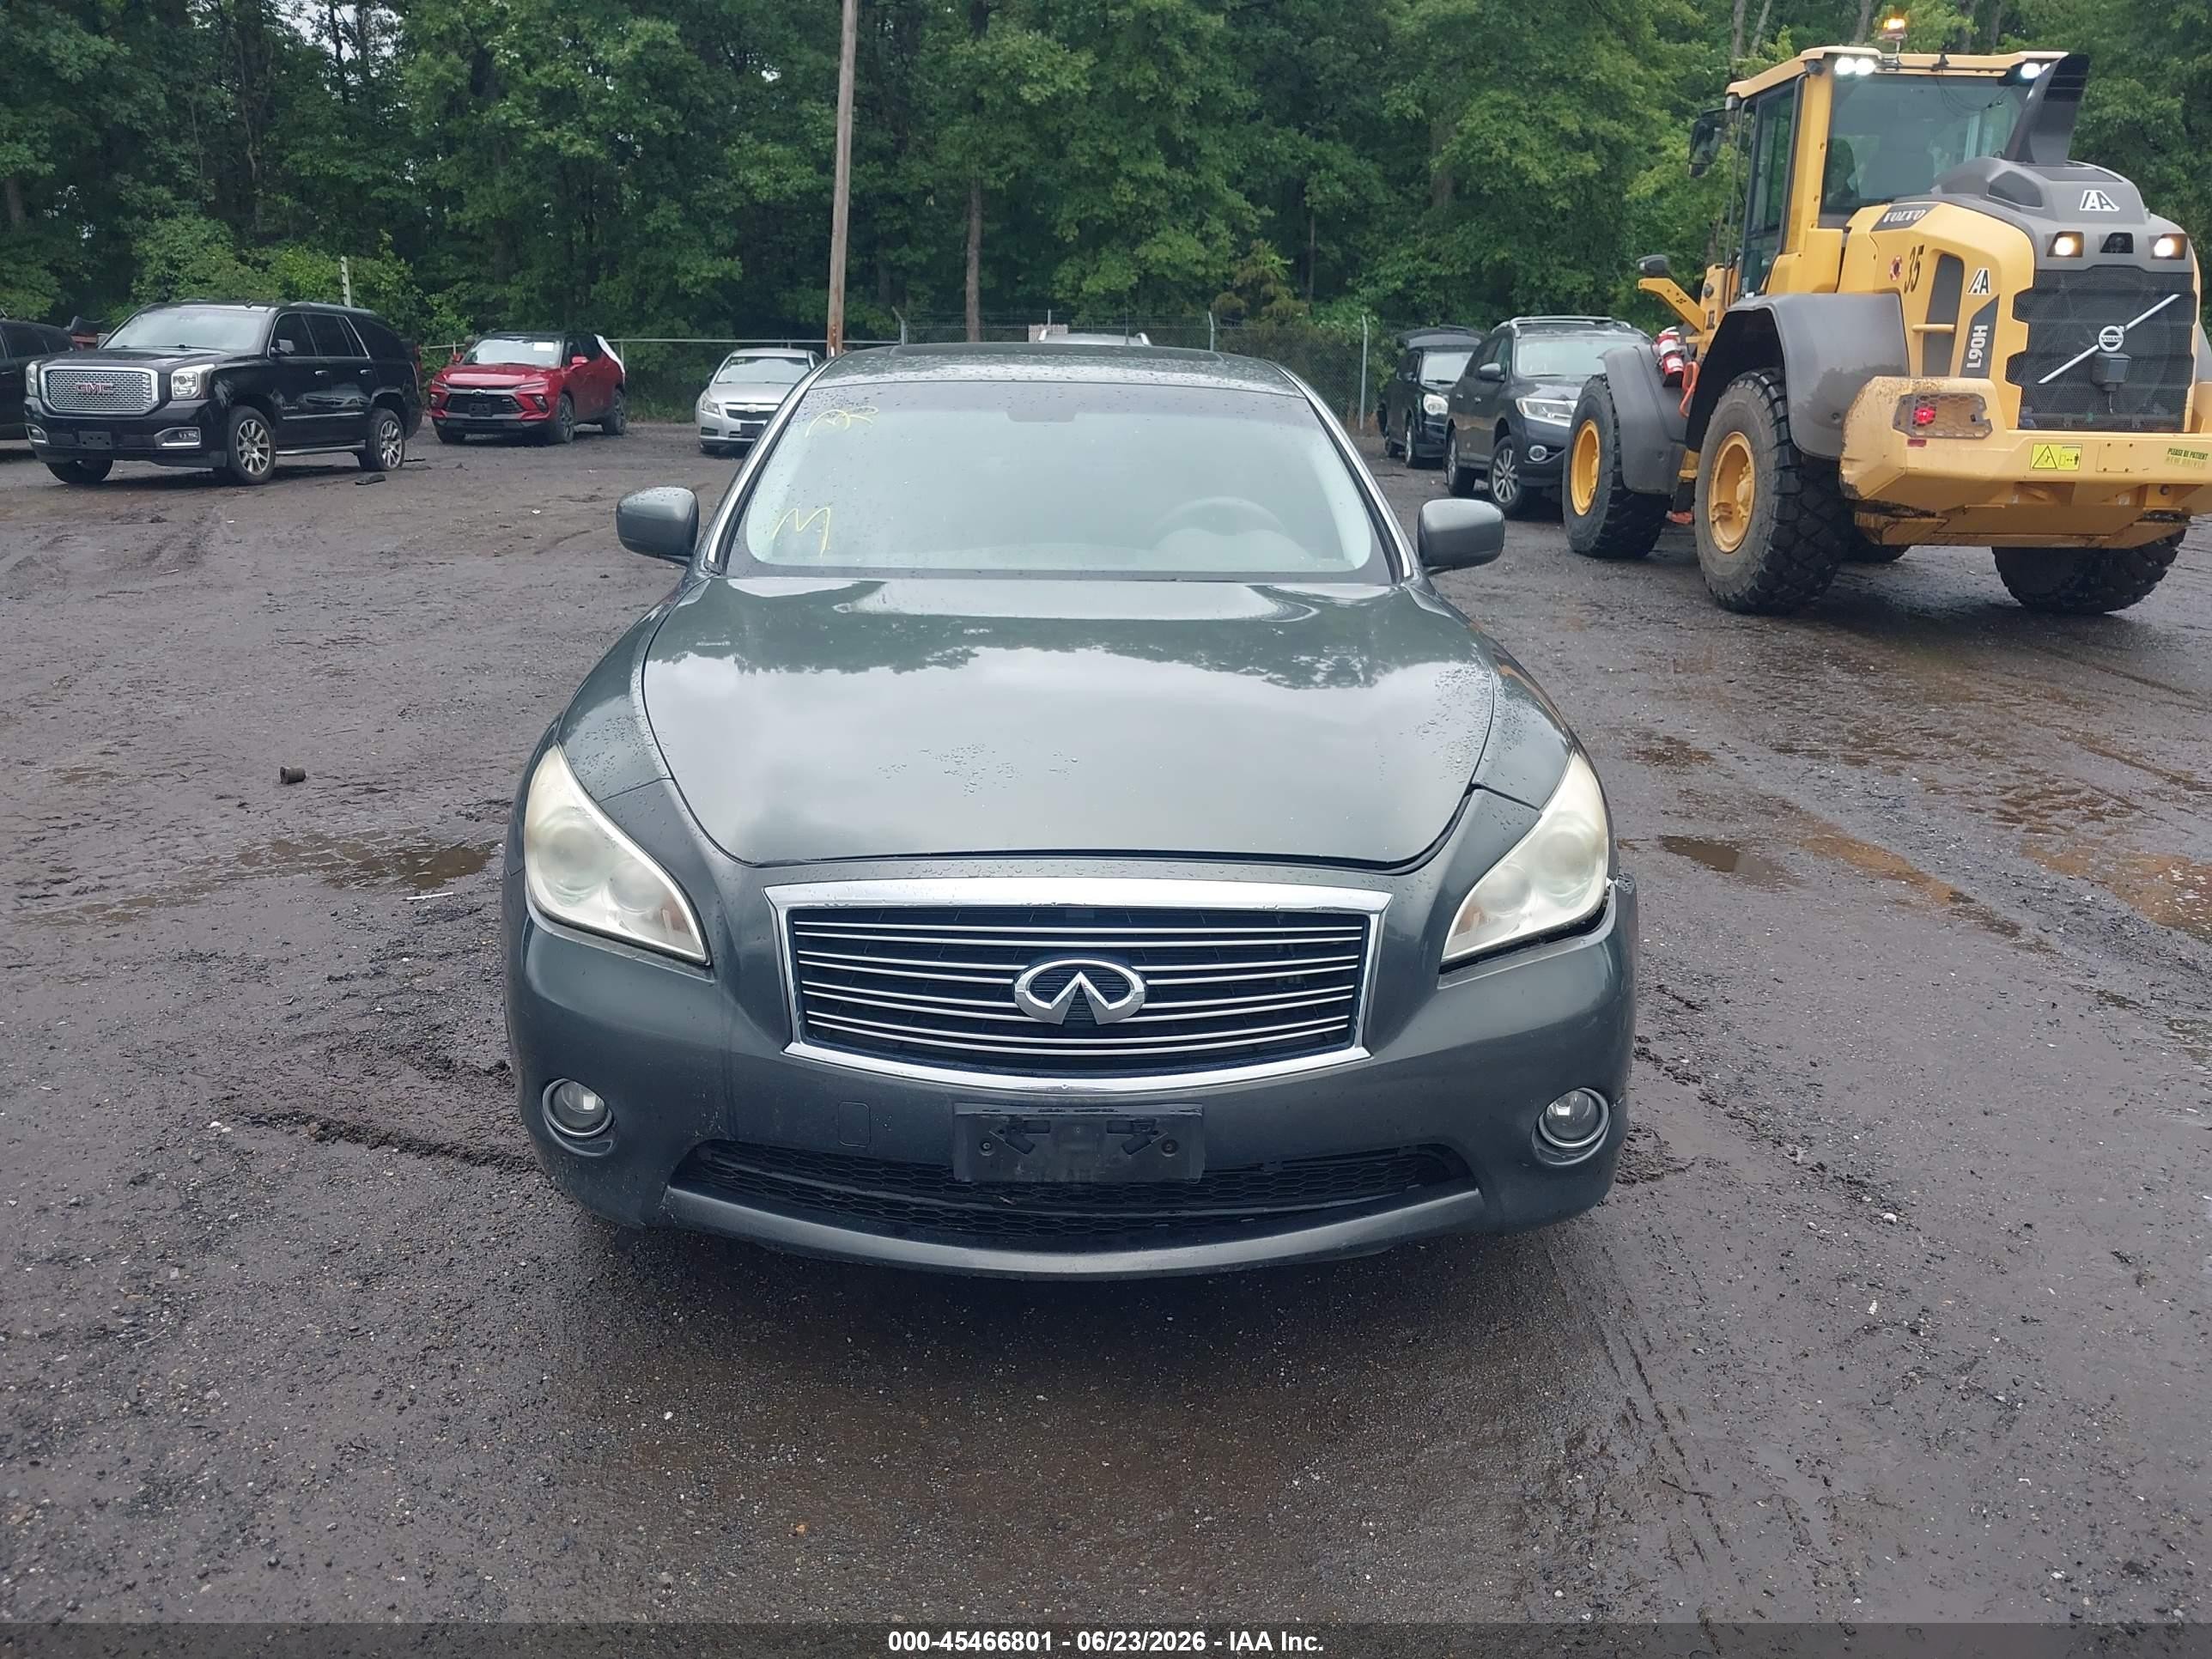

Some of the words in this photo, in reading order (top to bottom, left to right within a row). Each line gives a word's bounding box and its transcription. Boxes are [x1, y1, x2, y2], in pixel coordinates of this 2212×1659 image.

[1883, 209, 1927, 223] VOLVO
[1904, 244, 1925, 294] 35
[1966, 325, 1989, 368] L90H
[75, 382, 113, 394] GMC
